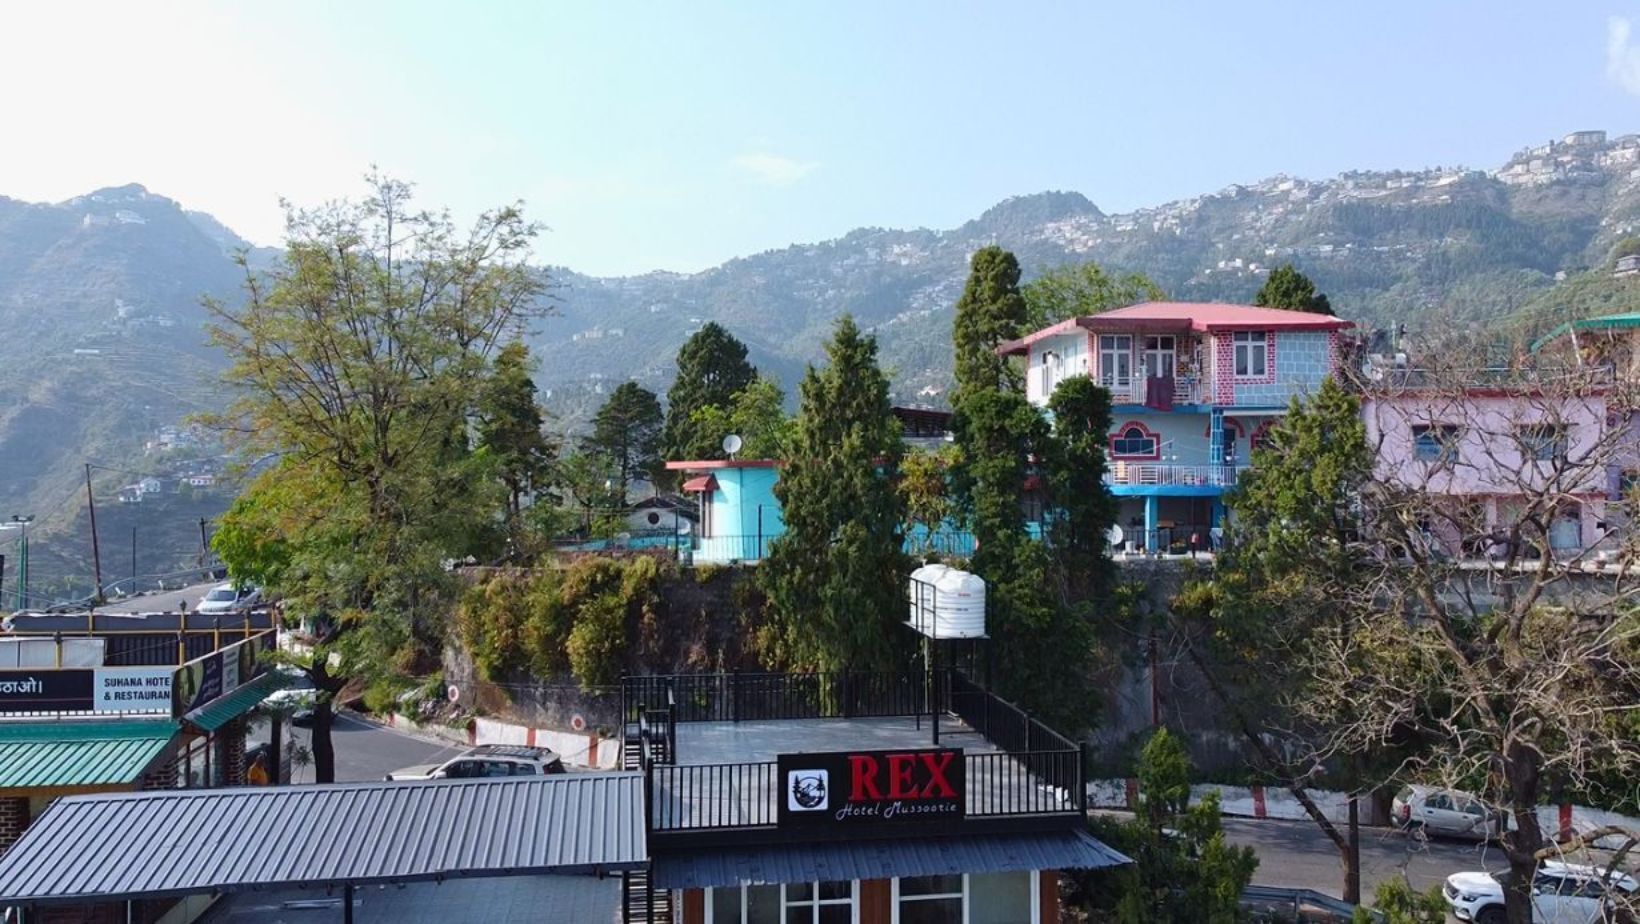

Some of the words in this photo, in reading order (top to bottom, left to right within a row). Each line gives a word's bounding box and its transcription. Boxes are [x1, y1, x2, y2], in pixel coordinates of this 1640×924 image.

[0, 676, 43, 694] ठाओ।
[104, 677, 143, 688] SUHANA
[145, 676, 170, 687] HOTE
[103, 691, 111, 701] &
[114, 690, 170, 700] RESTAURAN
[848, 752, 958, 801] REX
[835, 802, 880, 821] Hotel
[883, 801, 957, 819] Mussoorie
